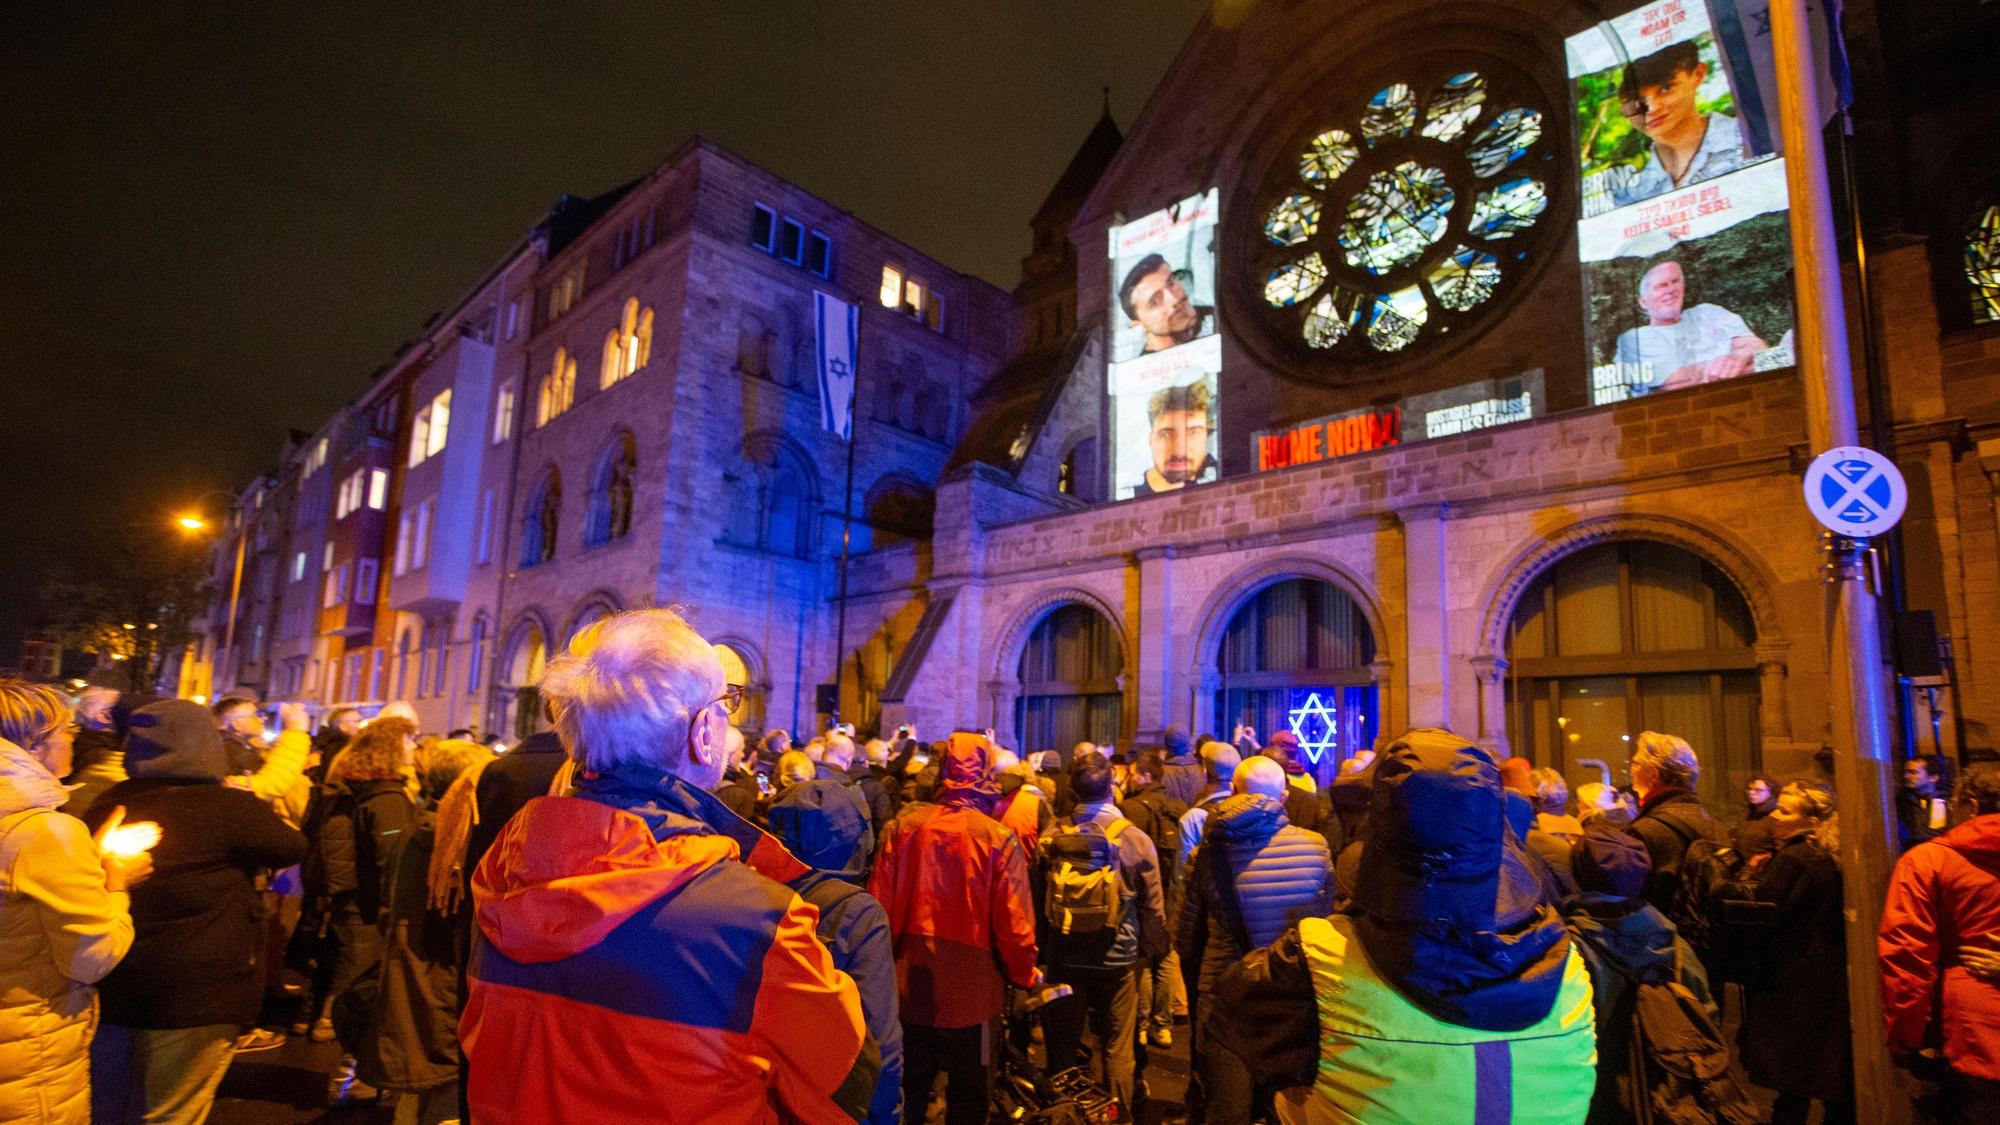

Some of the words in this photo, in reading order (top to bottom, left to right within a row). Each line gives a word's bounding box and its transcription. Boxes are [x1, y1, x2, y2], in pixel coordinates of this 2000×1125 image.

[1593, 361, 1655, 389] BRING
[1259, 424, 1322, 472] HOME
[1327, 404, 1400, 458] NOW!
